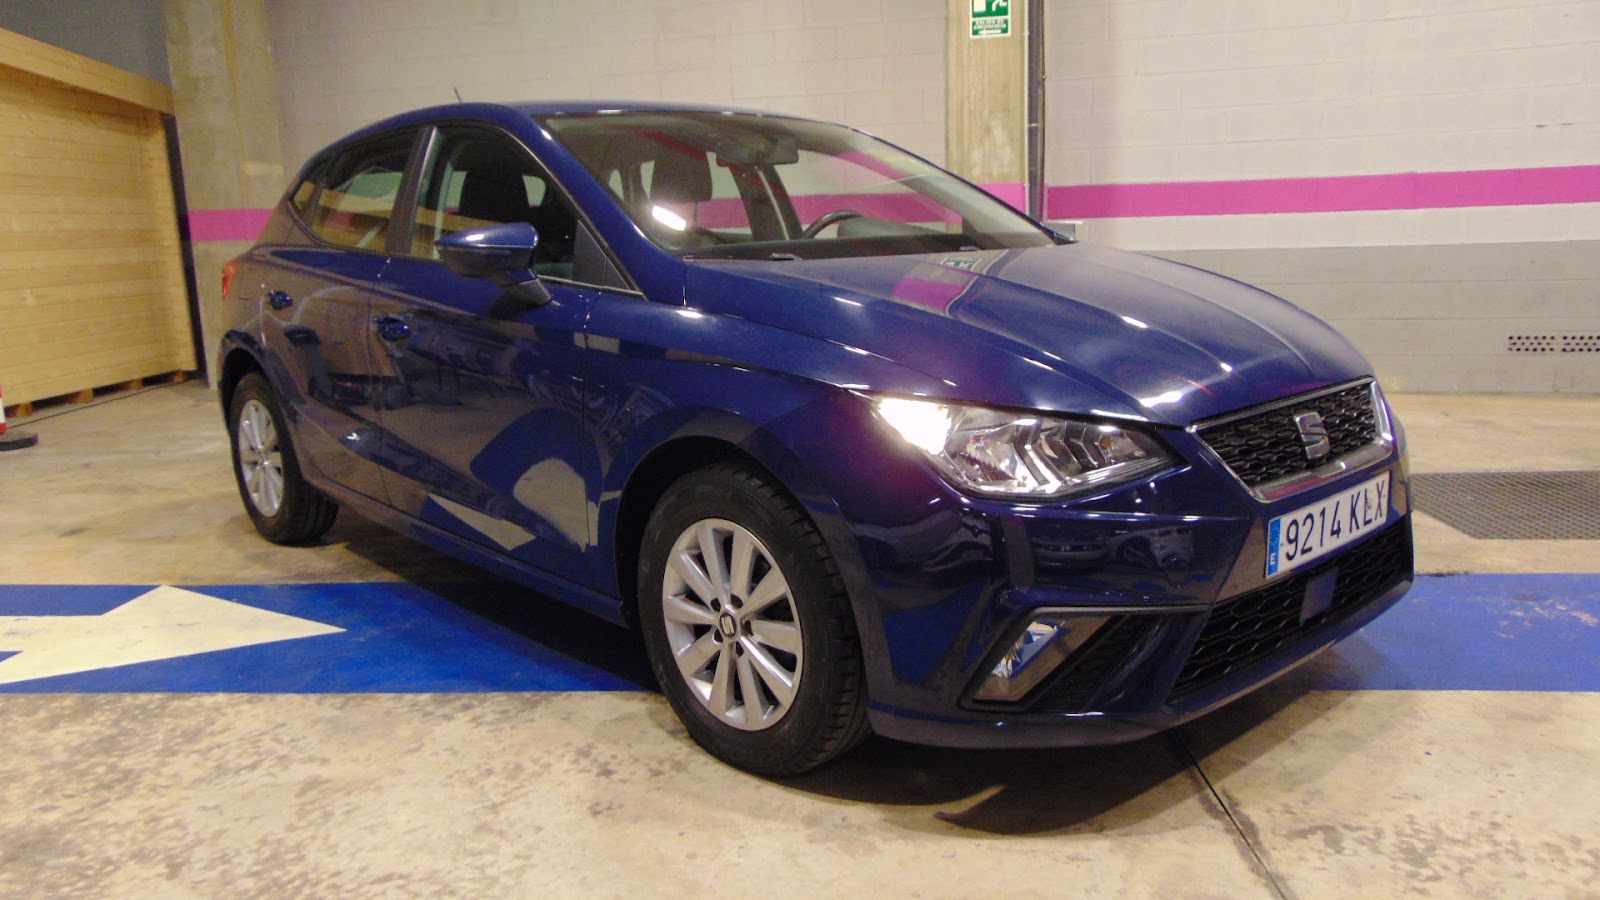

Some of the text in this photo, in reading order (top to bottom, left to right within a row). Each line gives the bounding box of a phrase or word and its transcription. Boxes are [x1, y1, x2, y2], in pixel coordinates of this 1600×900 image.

[1285, 480, 1386, 561] 9214 KLX
[1269, 552, 1276, 566] E
